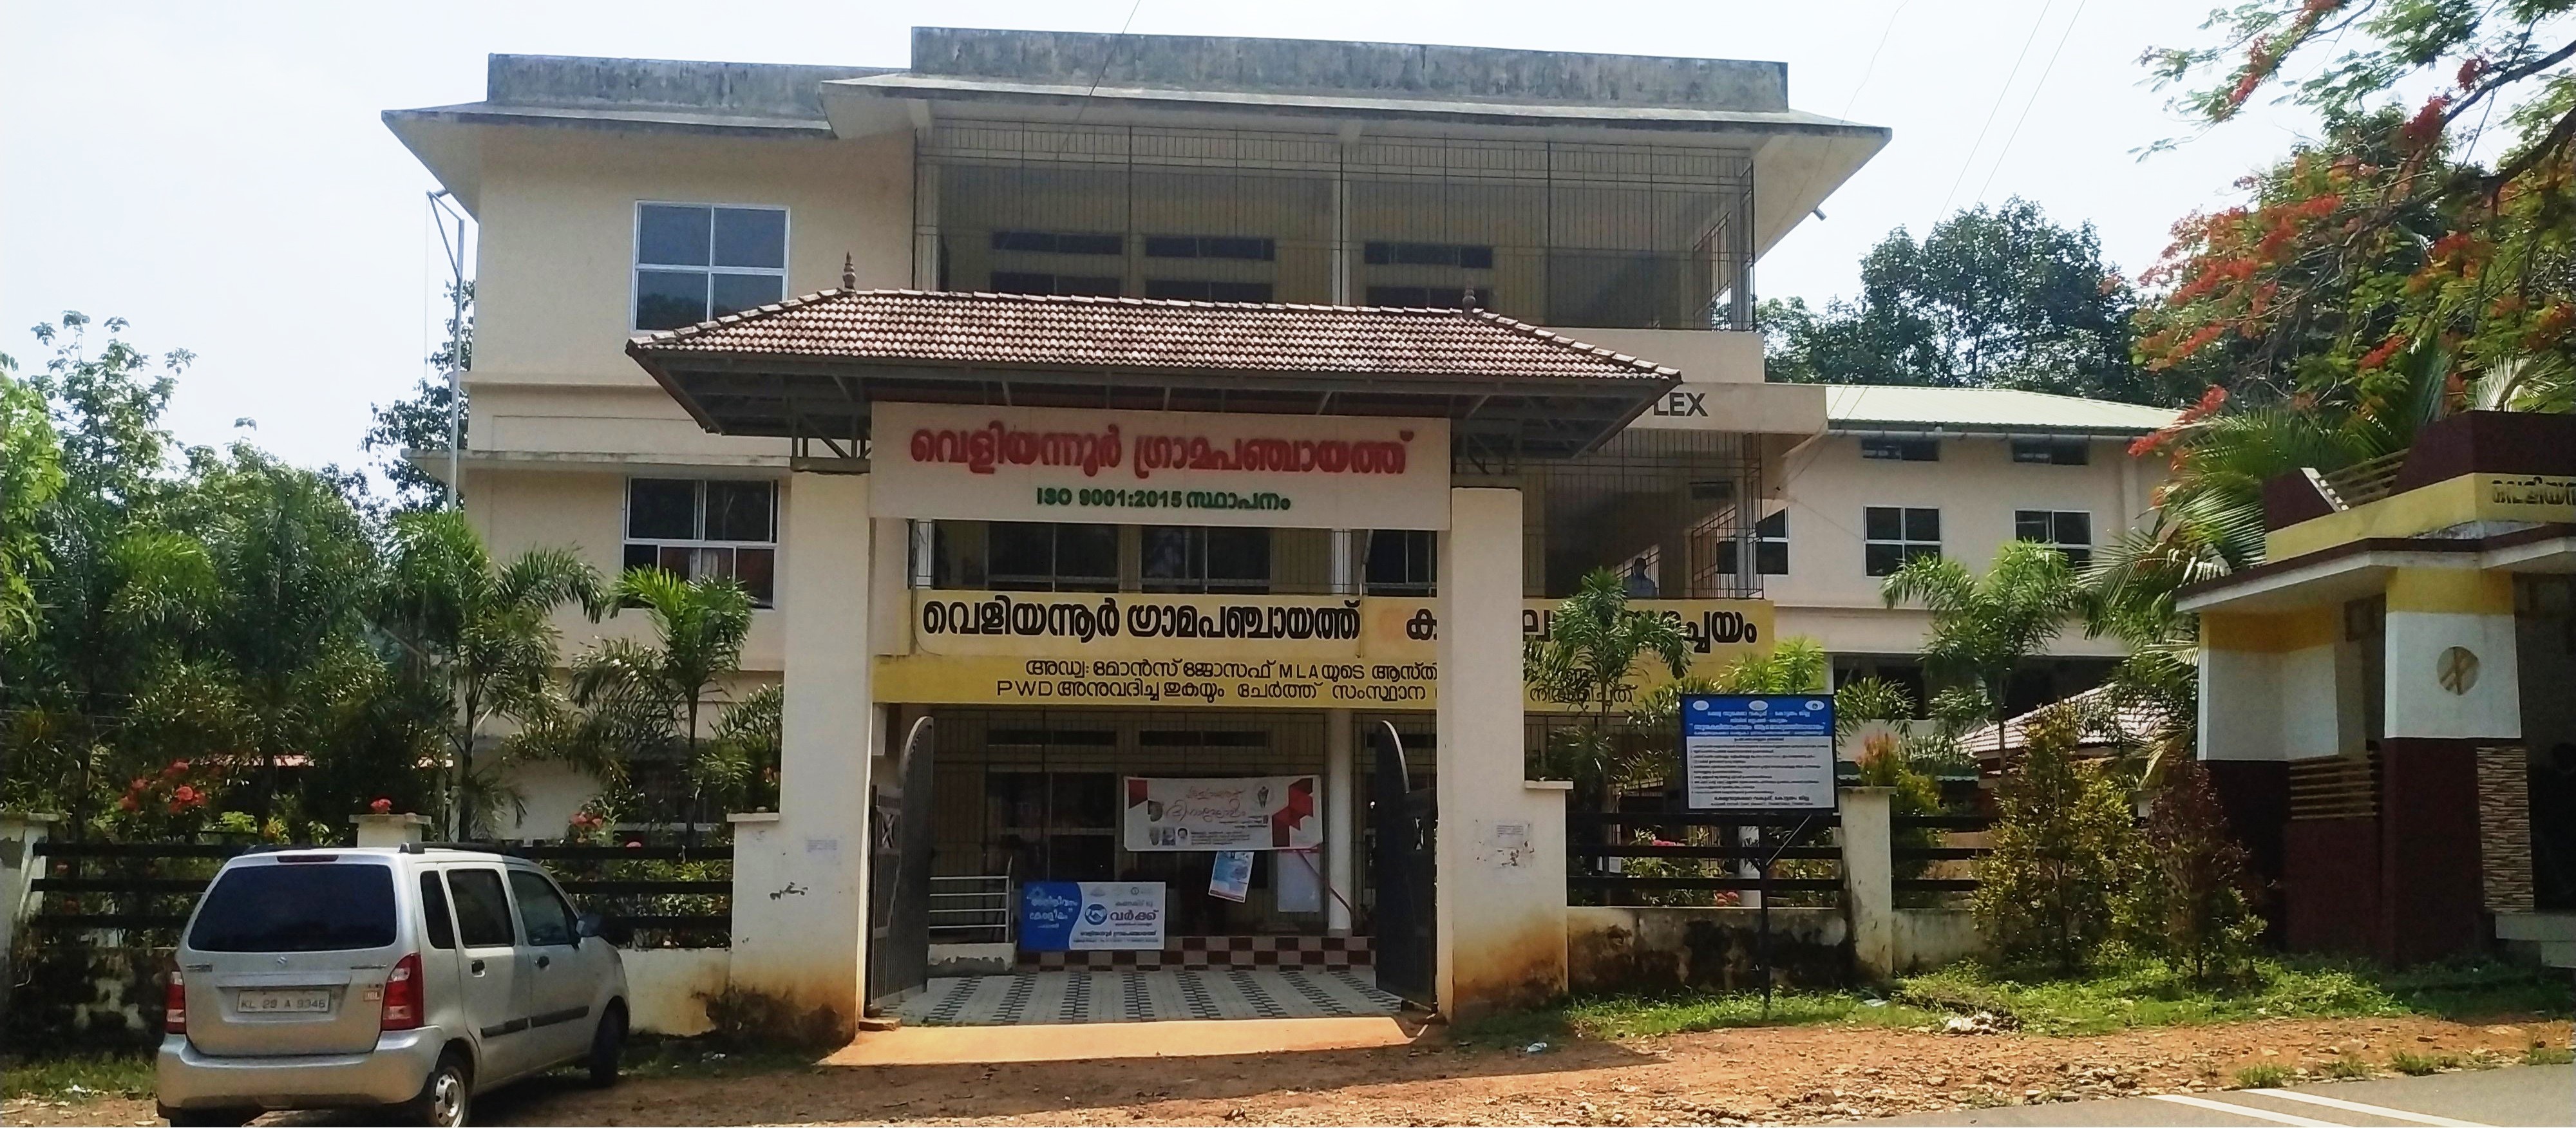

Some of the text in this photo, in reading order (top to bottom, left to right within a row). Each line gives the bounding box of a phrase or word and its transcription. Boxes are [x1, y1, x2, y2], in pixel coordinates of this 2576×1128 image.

[910, 420, 1415, 478] വെളിയന്നൂർ ഗ്രാമപഞ്ചായത്ത്
[1036, 487, 1292, 511] ISO 9001:2015 സ്ഥാപനം
[923, 594, 1121, 644] വെളിയന്നൂർ
[1126, 600, 1361, 639] ഗ്രാമപഞ്ചായത്ത്
[1025, 659, 1090, 679] അഡ്വ:
[1093, 658, 1184, 677] മോൻസ്
[1182, 659, 1276, 679] ജോസഫ്
[996, 681, 1054, 697] PWD
[1057, 678, 1160, 700] അനുവദിച്ച
[1163, 681, 1225, 703] തുകയും
[1236, 680, 1324, 699] ചേർത്ത്
[1331, 684, 1426, 702] സംസ്ഥാന
[1110, 909, 1159, 921] വർക്ക്
[241, 999, 255, 1008] KL
